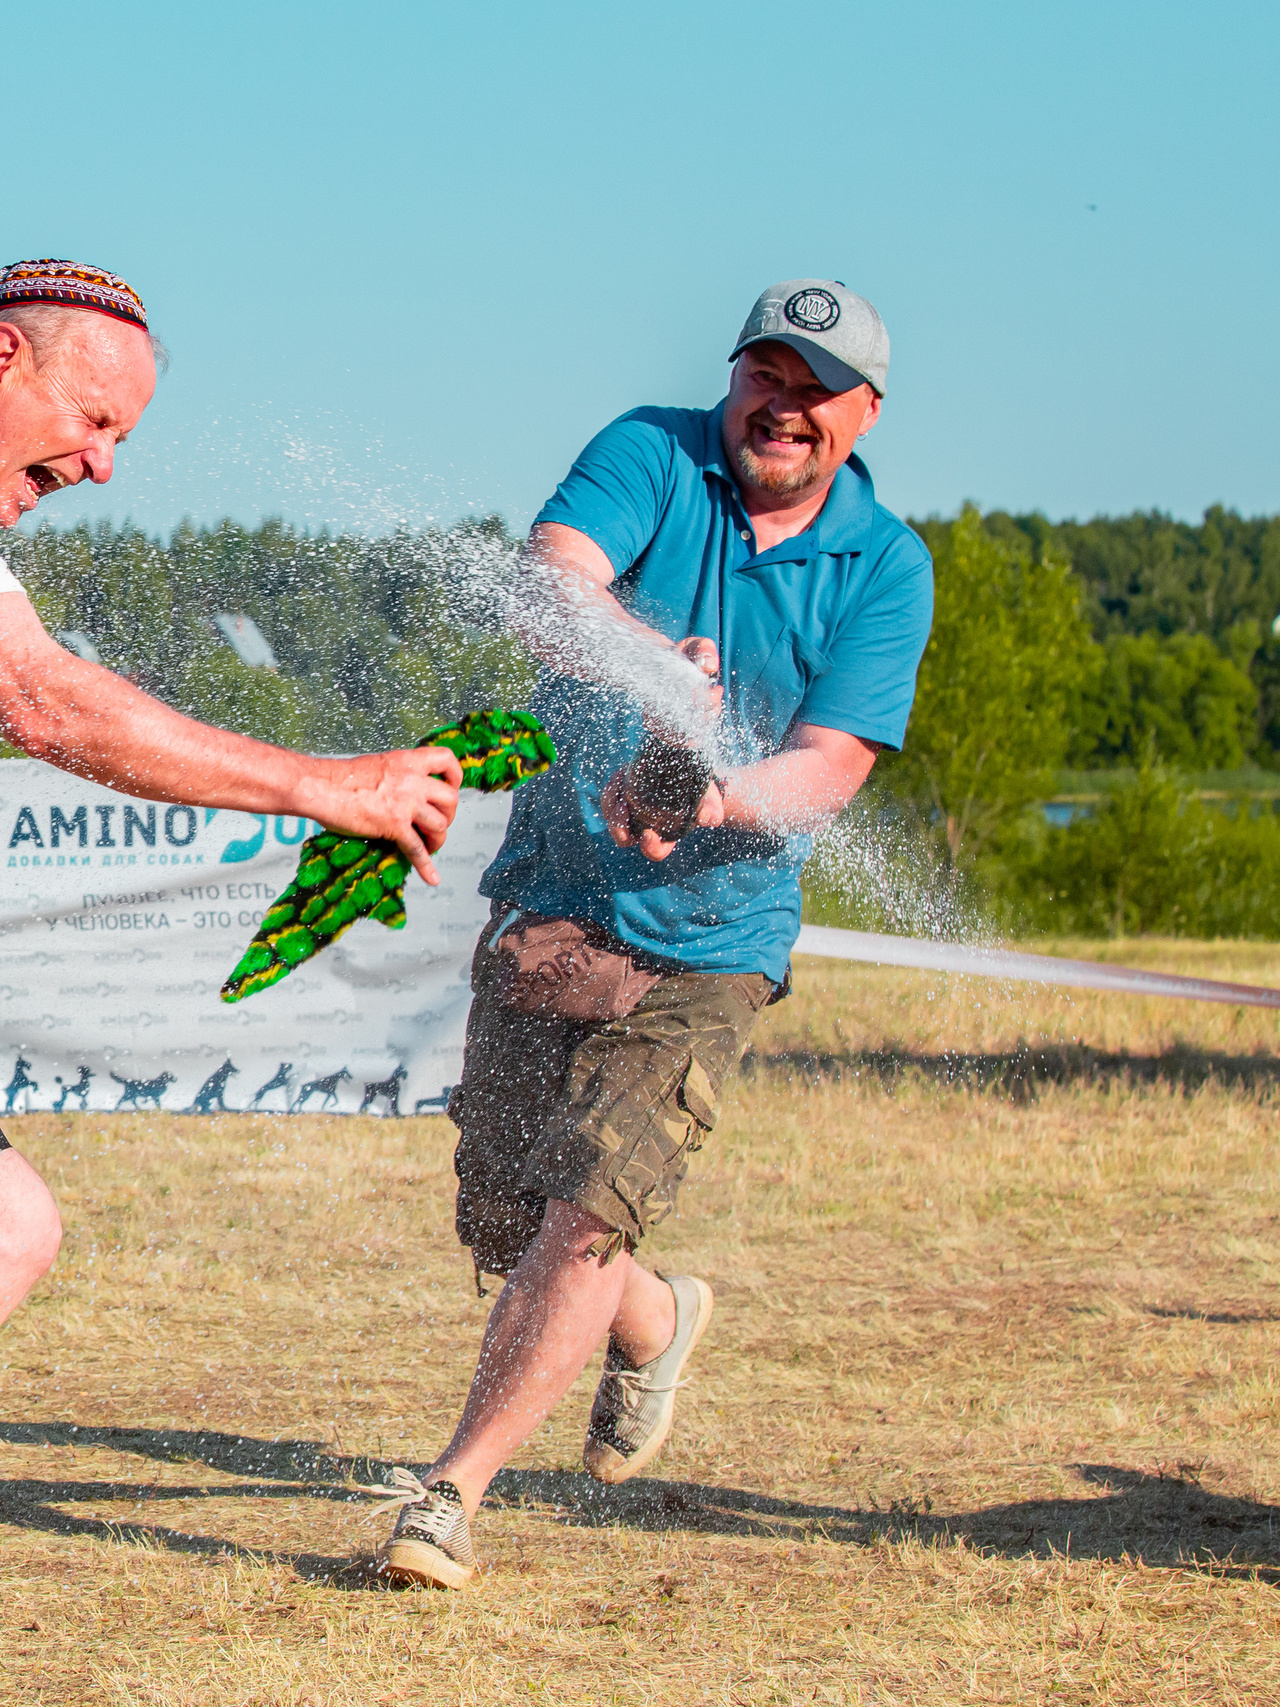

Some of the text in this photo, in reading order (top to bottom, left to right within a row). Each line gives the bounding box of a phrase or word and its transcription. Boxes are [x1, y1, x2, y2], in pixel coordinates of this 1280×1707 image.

[797, 295, 830, 321] NY
[7, 853, 205, 868] ДОБАВКИ ДЛЯ СОБАК
[181, 884, 220, 900] ЧТО
[227, 882, 277, 900] ЕСТЬ
[65, 912, 170, 930] ЧЕЛОВЕКА
[193, 911, 231, 929] ЭТО
